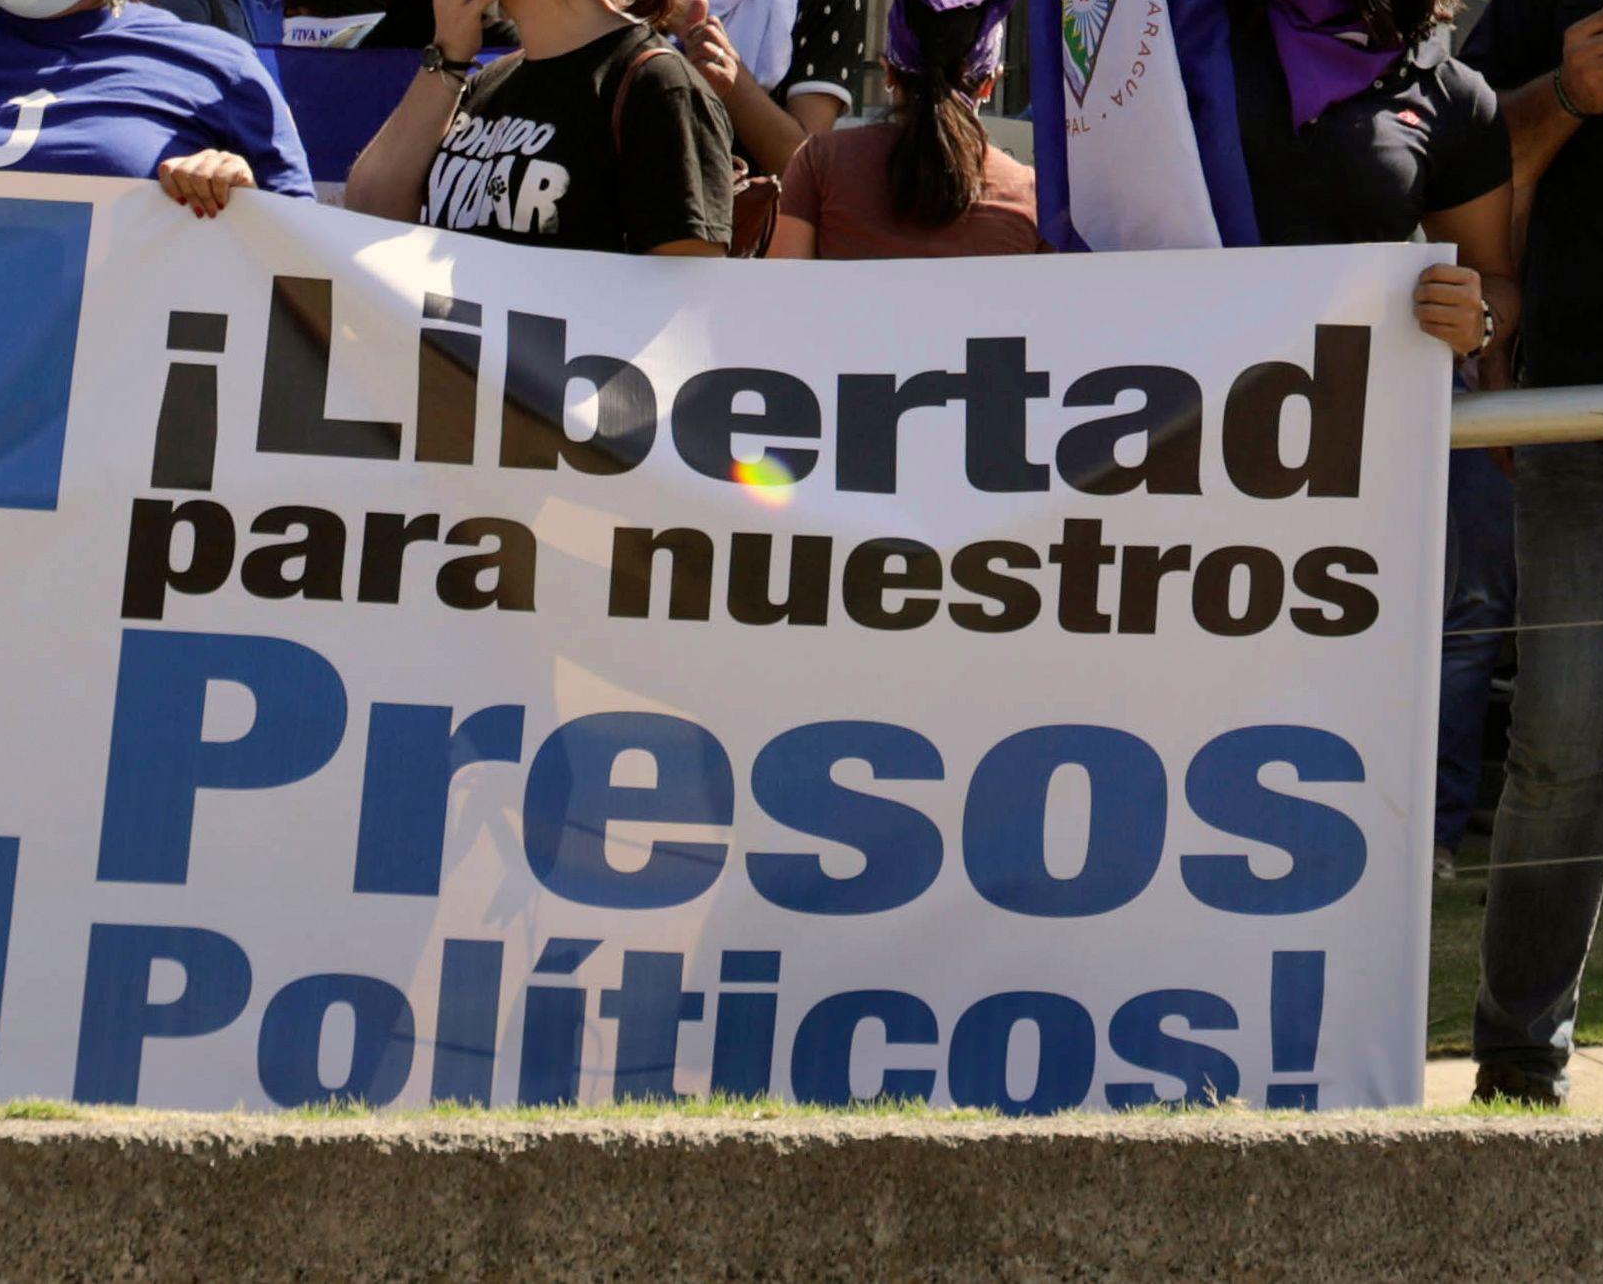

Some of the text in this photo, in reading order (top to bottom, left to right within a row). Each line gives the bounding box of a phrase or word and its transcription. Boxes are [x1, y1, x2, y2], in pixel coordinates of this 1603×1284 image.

[151, 275, 1373, 501] ¡Libertad
[121, 497, 1381, 638] para nuestros
[96, 627, 1368, 919] Presos
[72, 922, 1327, 1114] Políticos!
